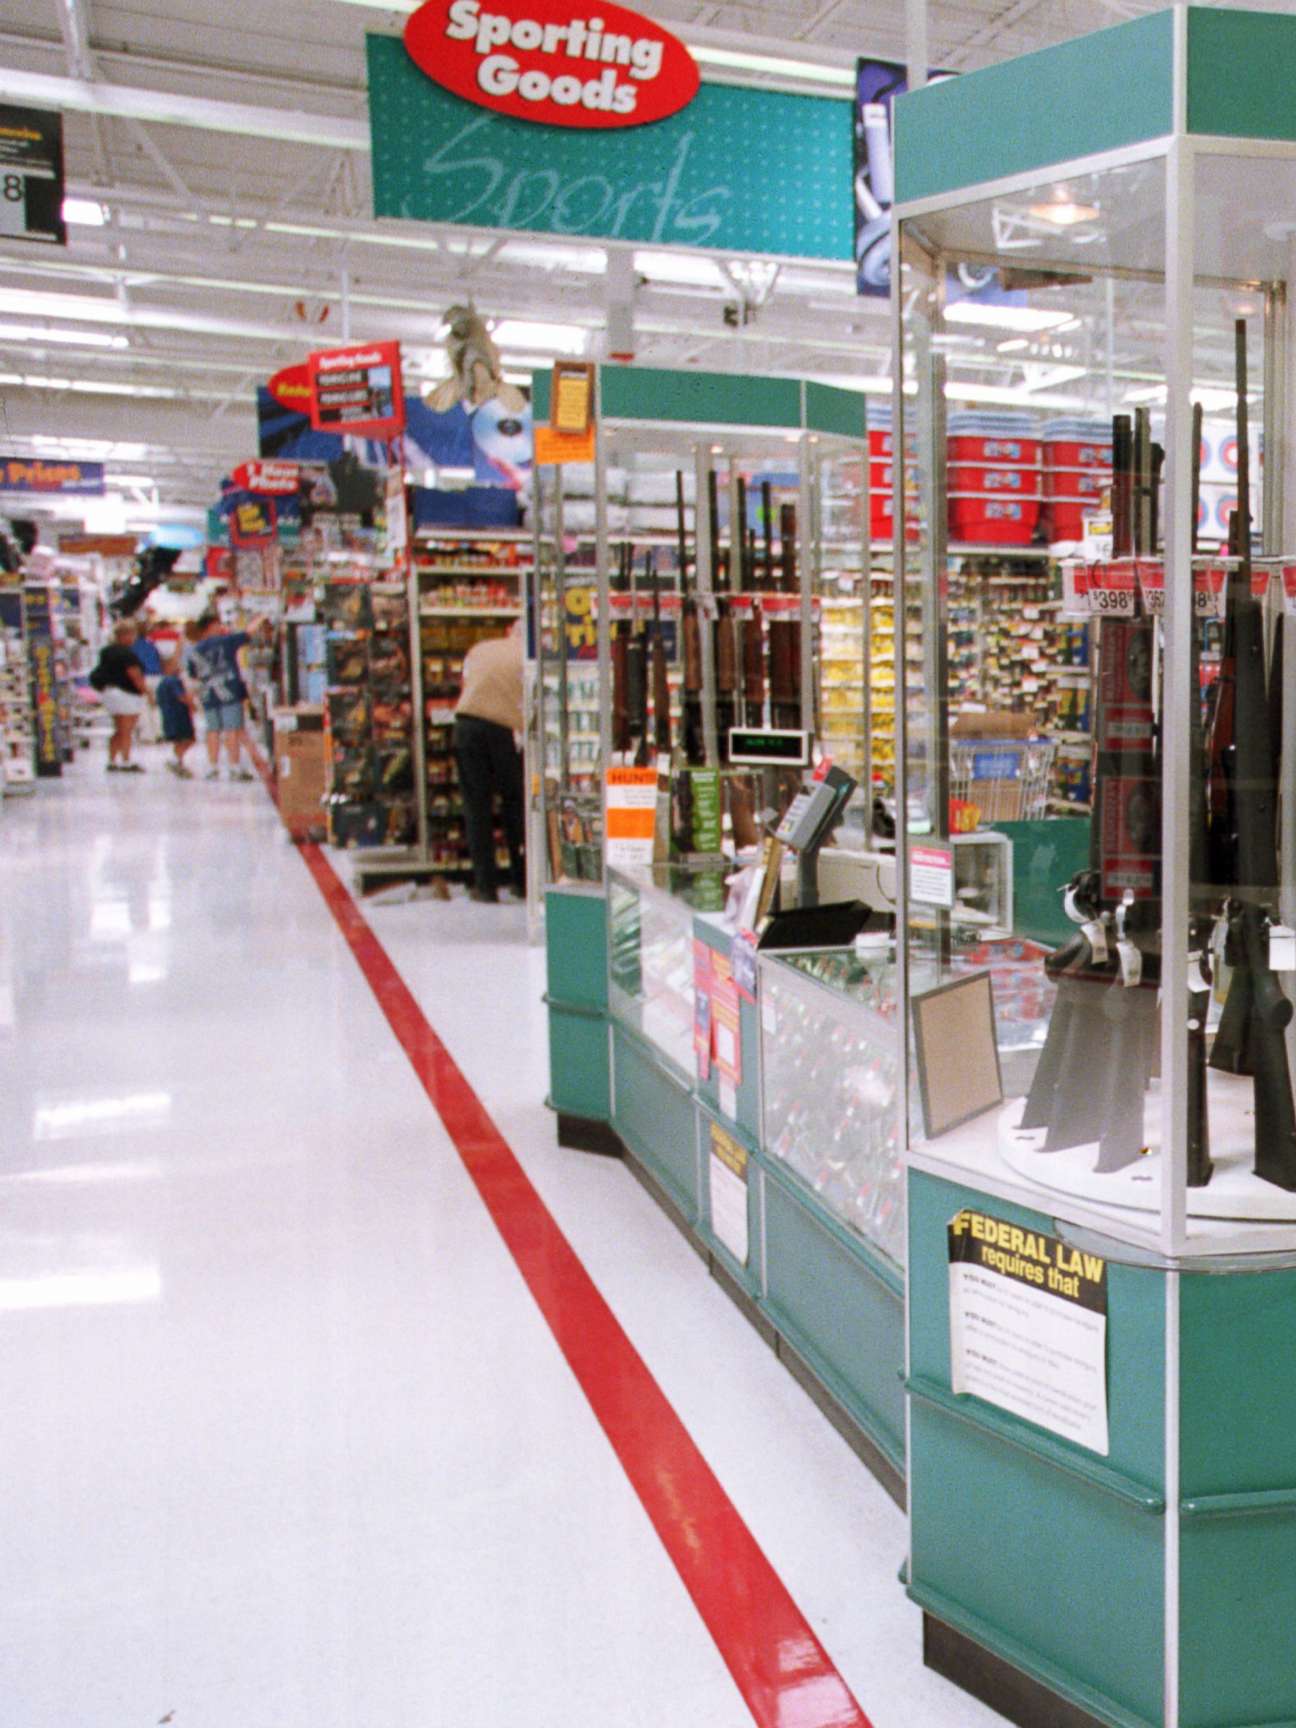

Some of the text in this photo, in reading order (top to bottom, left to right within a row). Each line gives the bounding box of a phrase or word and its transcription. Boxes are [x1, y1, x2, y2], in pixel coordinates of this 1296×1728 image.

[446, 0, 664, 80] Sporting
[476, 55, 638, 114] Goods
[402, 112, 731, 247] Sports
[954, 1212, 1104, 1283] FEDERAL LAW
[981, 1246, 1080, 1298] requires that
